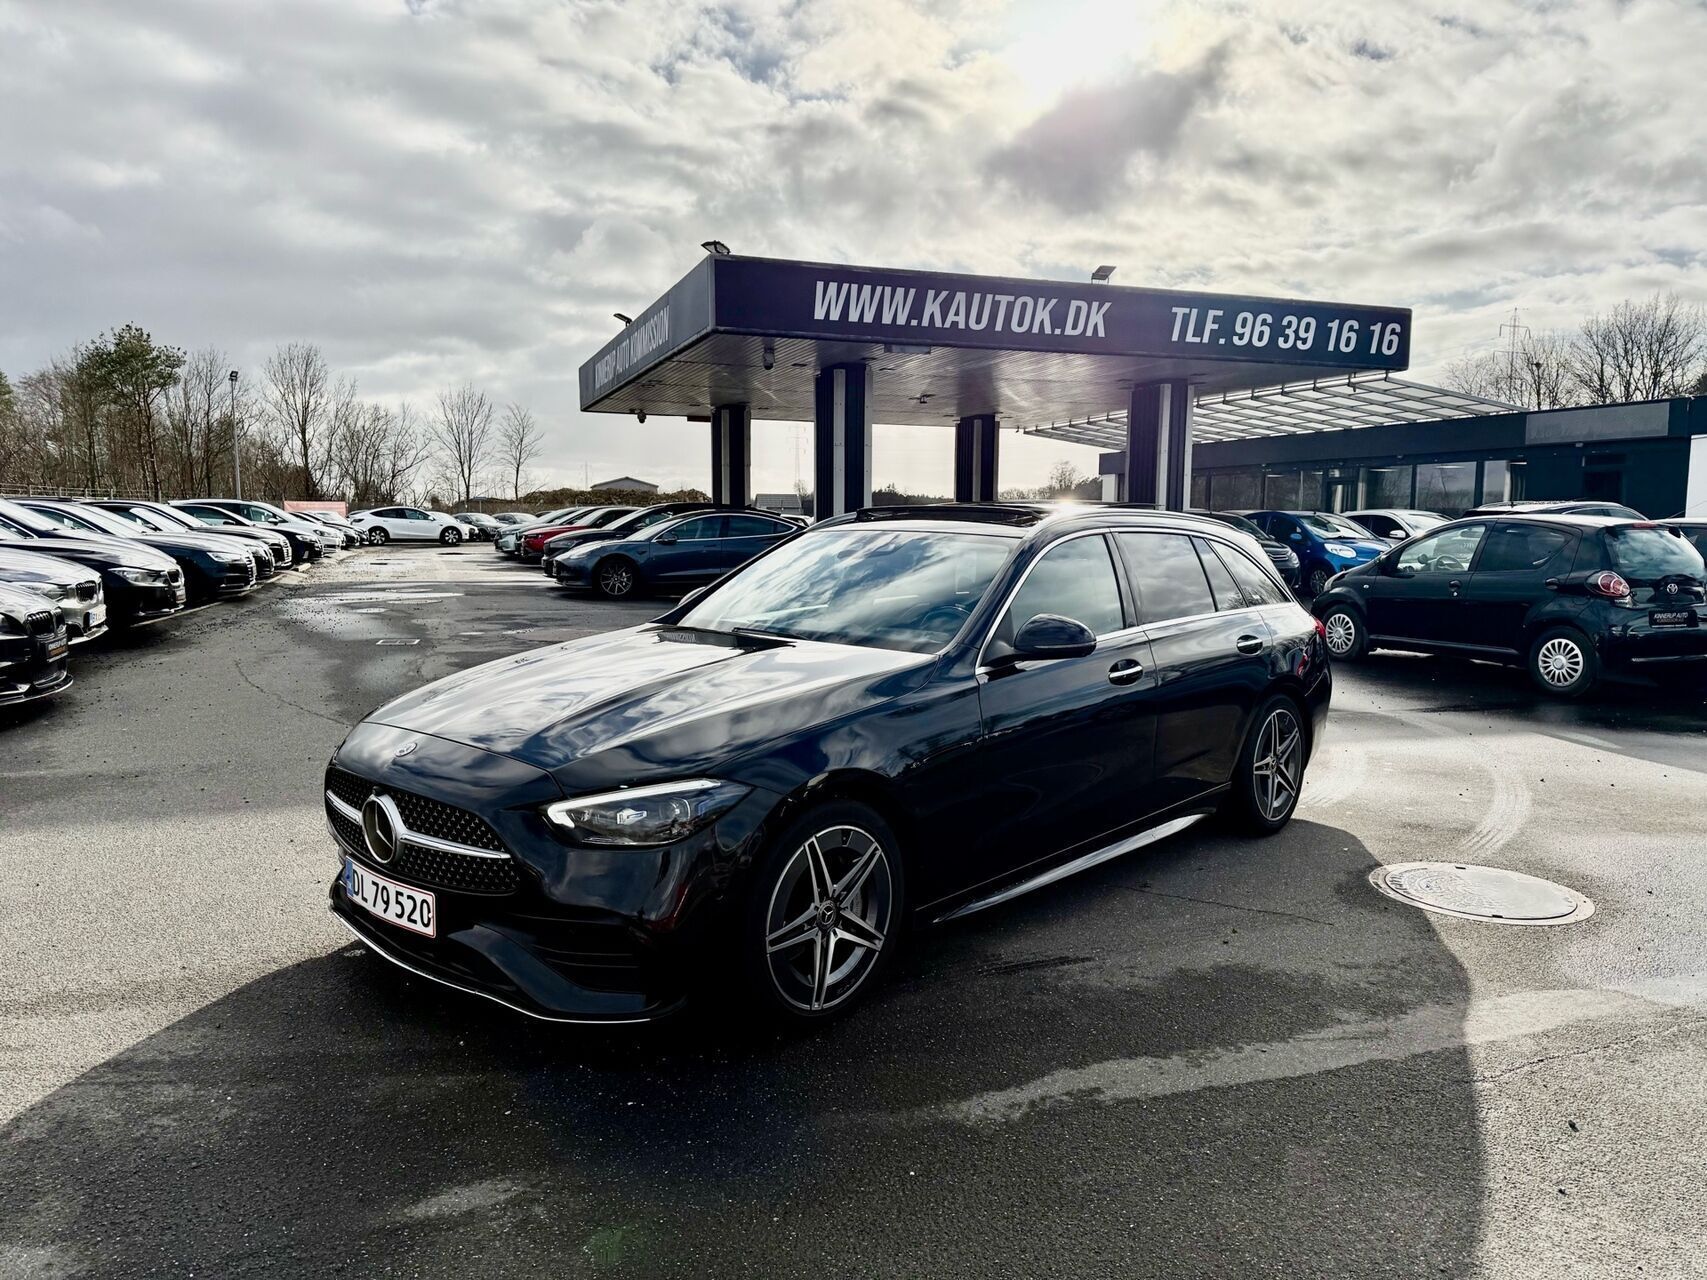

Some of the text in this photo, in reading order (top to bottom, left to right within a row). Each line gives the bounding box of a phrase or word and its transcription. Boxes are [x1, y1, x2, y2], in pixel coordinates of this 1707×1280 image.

[813, 281, 1112, 338] WWW.KAUTOK.DK
[1171, 307, 1401, 356] TLF. 96 39 16 16
[352, 868, 431, 928] DL 79 520
